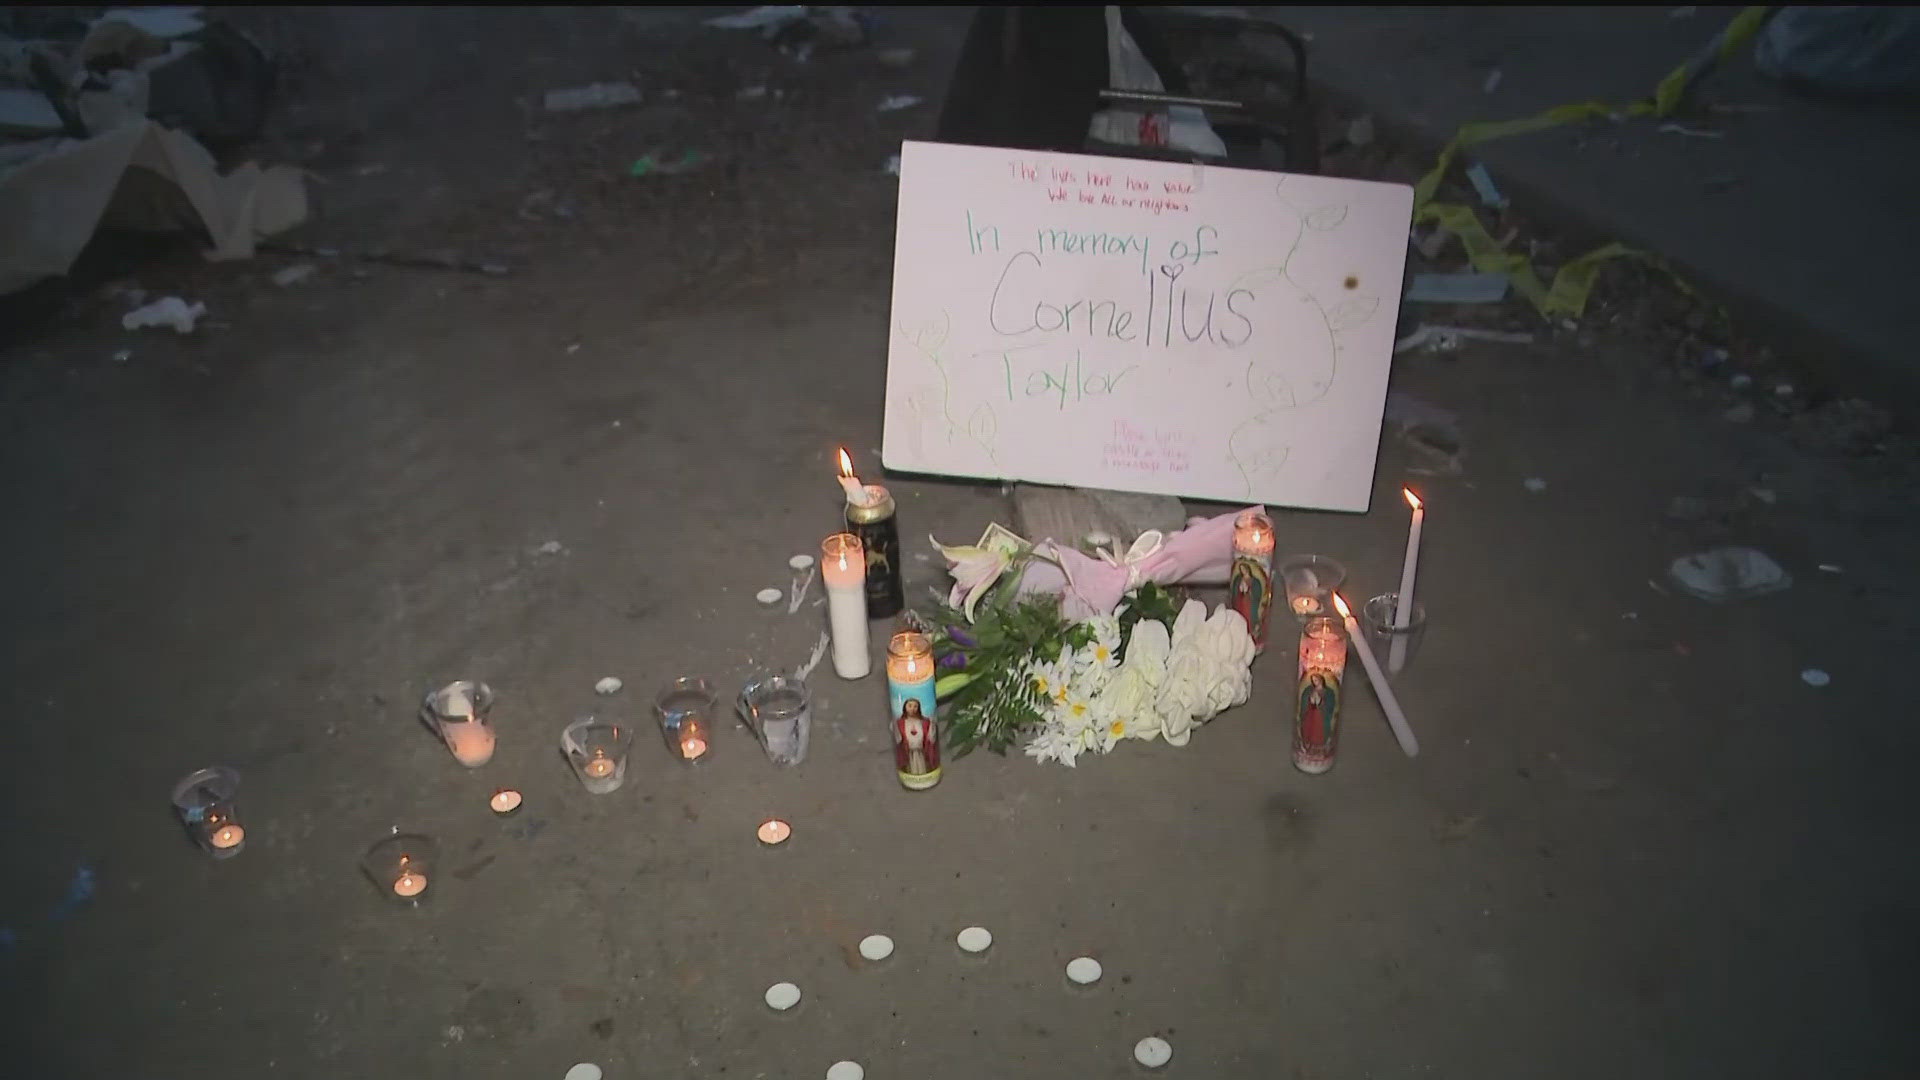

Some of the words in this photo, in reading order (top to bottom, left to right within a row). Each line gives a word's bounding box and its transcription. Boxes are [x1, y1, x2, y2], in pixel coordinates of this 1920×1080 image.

[967, 209, 999, 254] In
[1038, 228, 1149, 275] memory
[1170, 225, 1218, 265] of
[989, 251, 1255, 347] Cornelius
[972, 346, 1139, 410] Taylor
